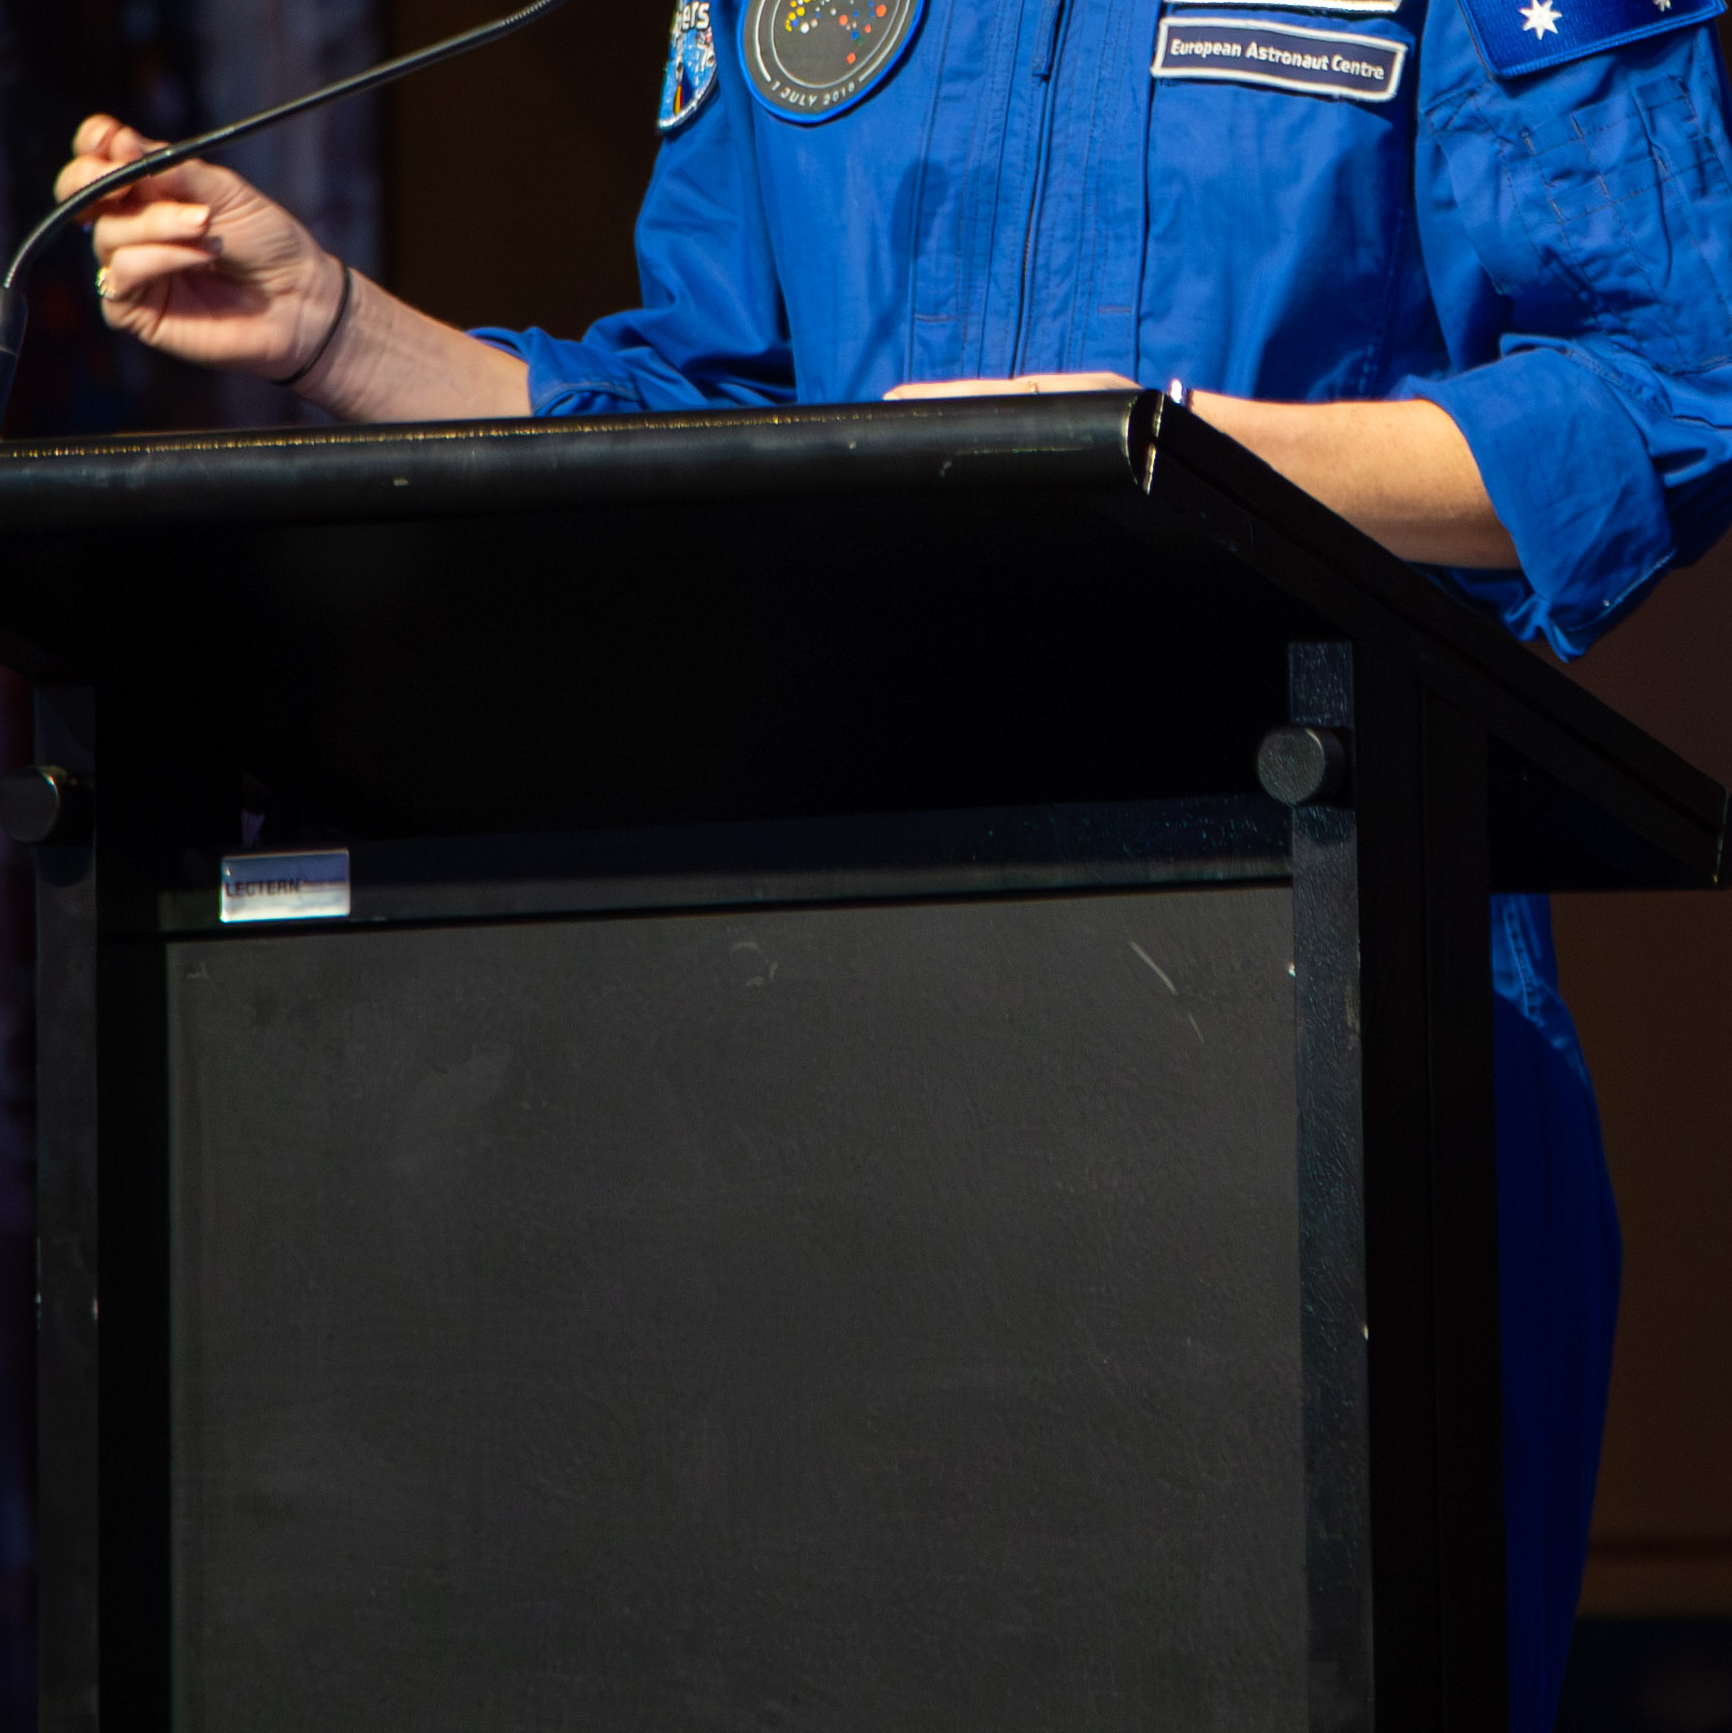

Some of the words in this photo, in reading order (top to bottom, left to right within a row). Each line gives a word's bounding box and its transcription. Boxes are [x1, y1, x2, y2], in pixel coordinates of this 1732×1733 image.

[1170, 38, 1242, 58] European
[1245, 41, 1329, 71] Astronaut
[1331, 54, 1385, 80] Centre
[780, 87, 818, 107] JULY
[224, 878, 301, 898] LECTERN
